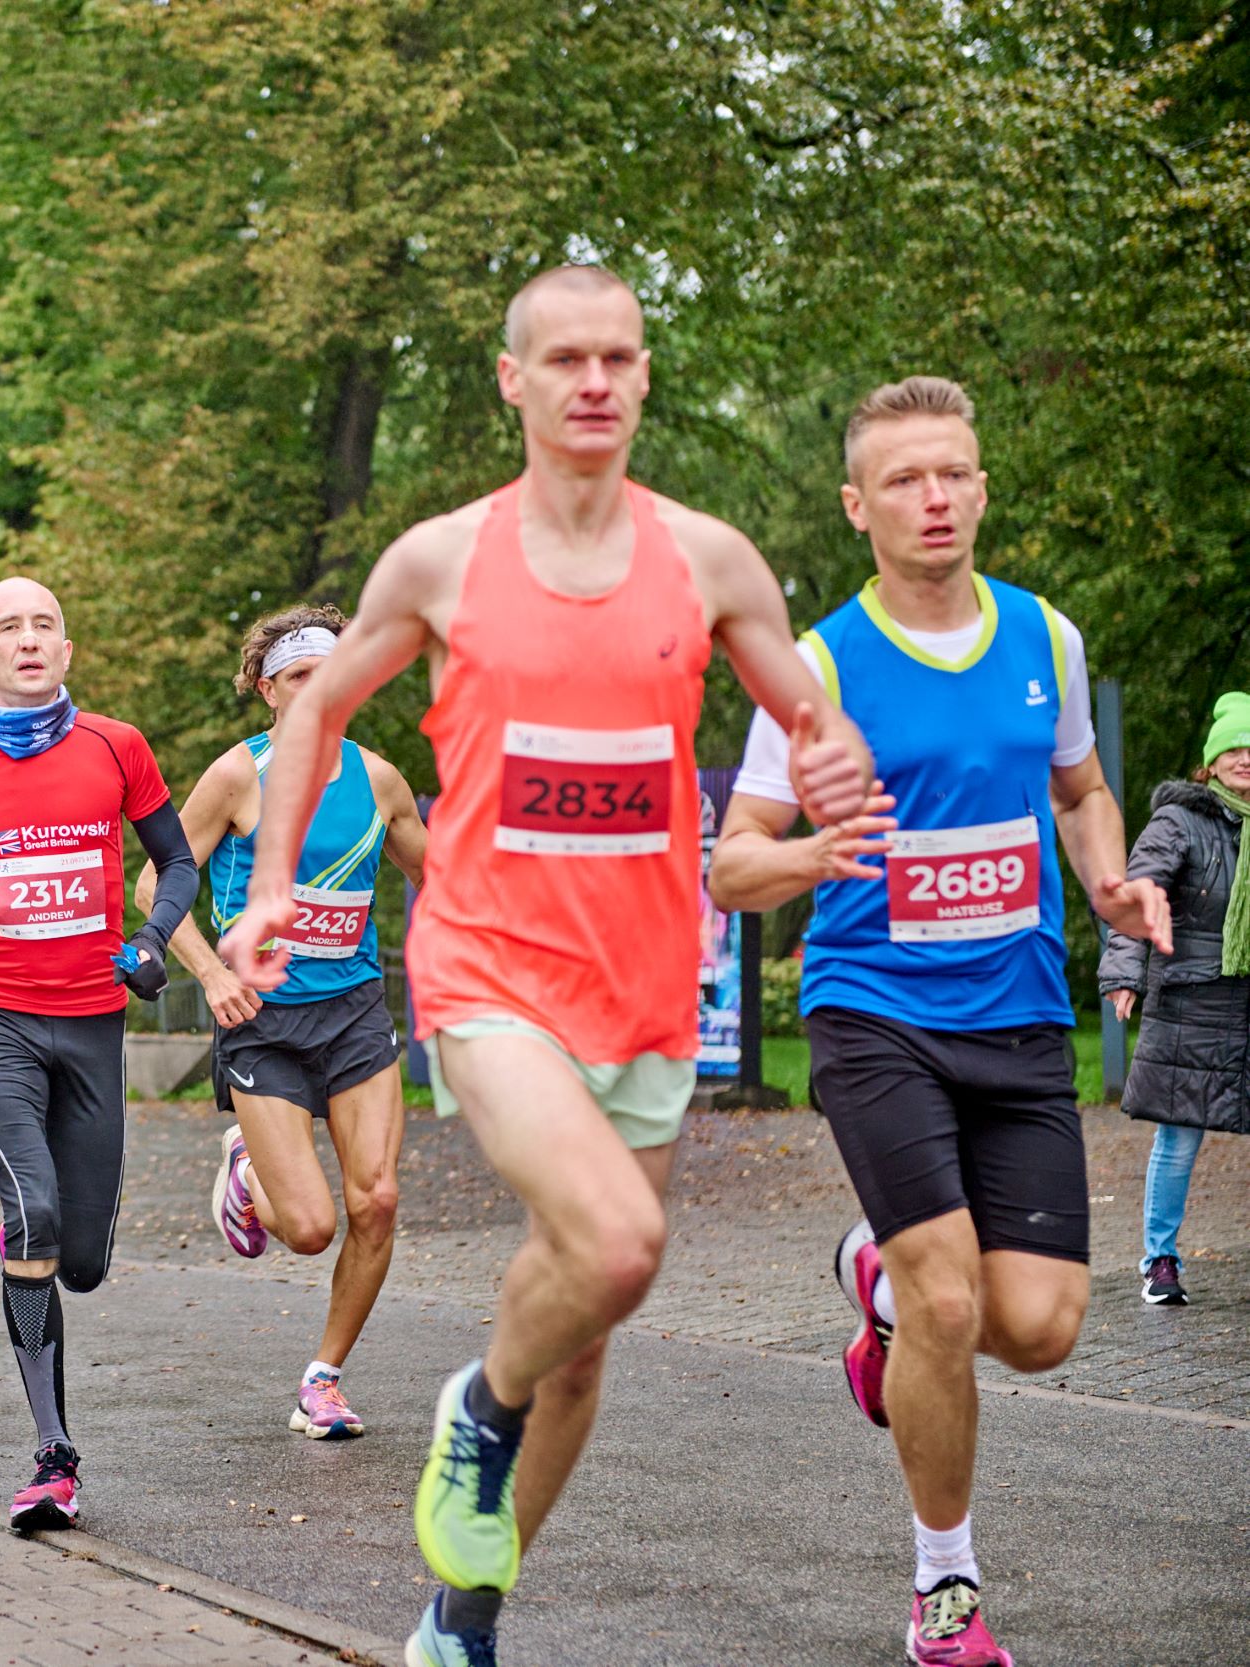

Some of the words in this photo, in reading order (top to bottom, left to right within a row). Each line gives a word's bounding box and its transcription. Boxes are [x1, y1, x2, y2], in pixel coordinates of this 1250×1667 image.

[521, 777, 652, 819] 2834
[20, 821, 110, 842] Kurowski
[24, 841, 49, 851] Great
[50, 838, 80, 847] Britain
[905, 855, 1025, 901] 2689
[9, 877, 89, 909] 2314
[27, 910, 75, 922] ANDREW
[937, 901, 1005, 918] MATEUSZ
[292, 907, 360, 934] 2426
[305, 936, 342, 946] ANDRZEJ
